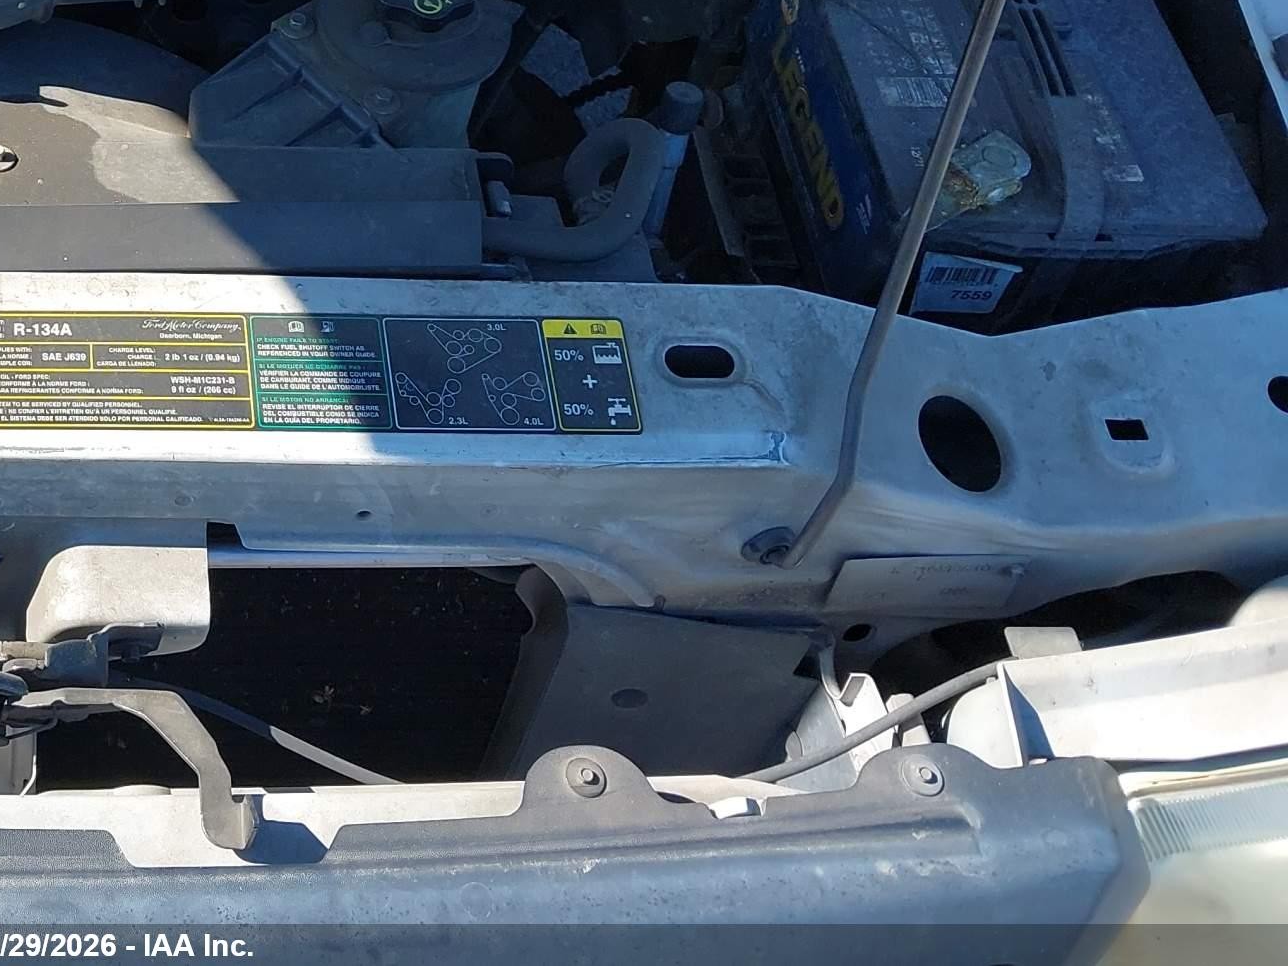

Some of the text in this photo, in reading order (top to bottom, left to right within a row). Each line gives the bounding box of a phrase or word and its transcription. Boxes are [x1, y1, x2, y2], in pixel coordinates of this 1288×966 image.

[951, 290, 993, 300] 7559
[13, 323, 73, 336] R-134A
[142, 319, 192, 331] Ford Motor
[487, 323, 507, 331] 3.0L
[42, 352, 87, 362] SAE J639
[226, 353, 241, 363] kg)
[554, 349, 584, 362] 50%
[222, 386, 236, 395] cc)
[563, 404, 594, 416] 50%
[448, 417, 469, 425] 2.3L
[523, 418, 544, 426] 4.0L
